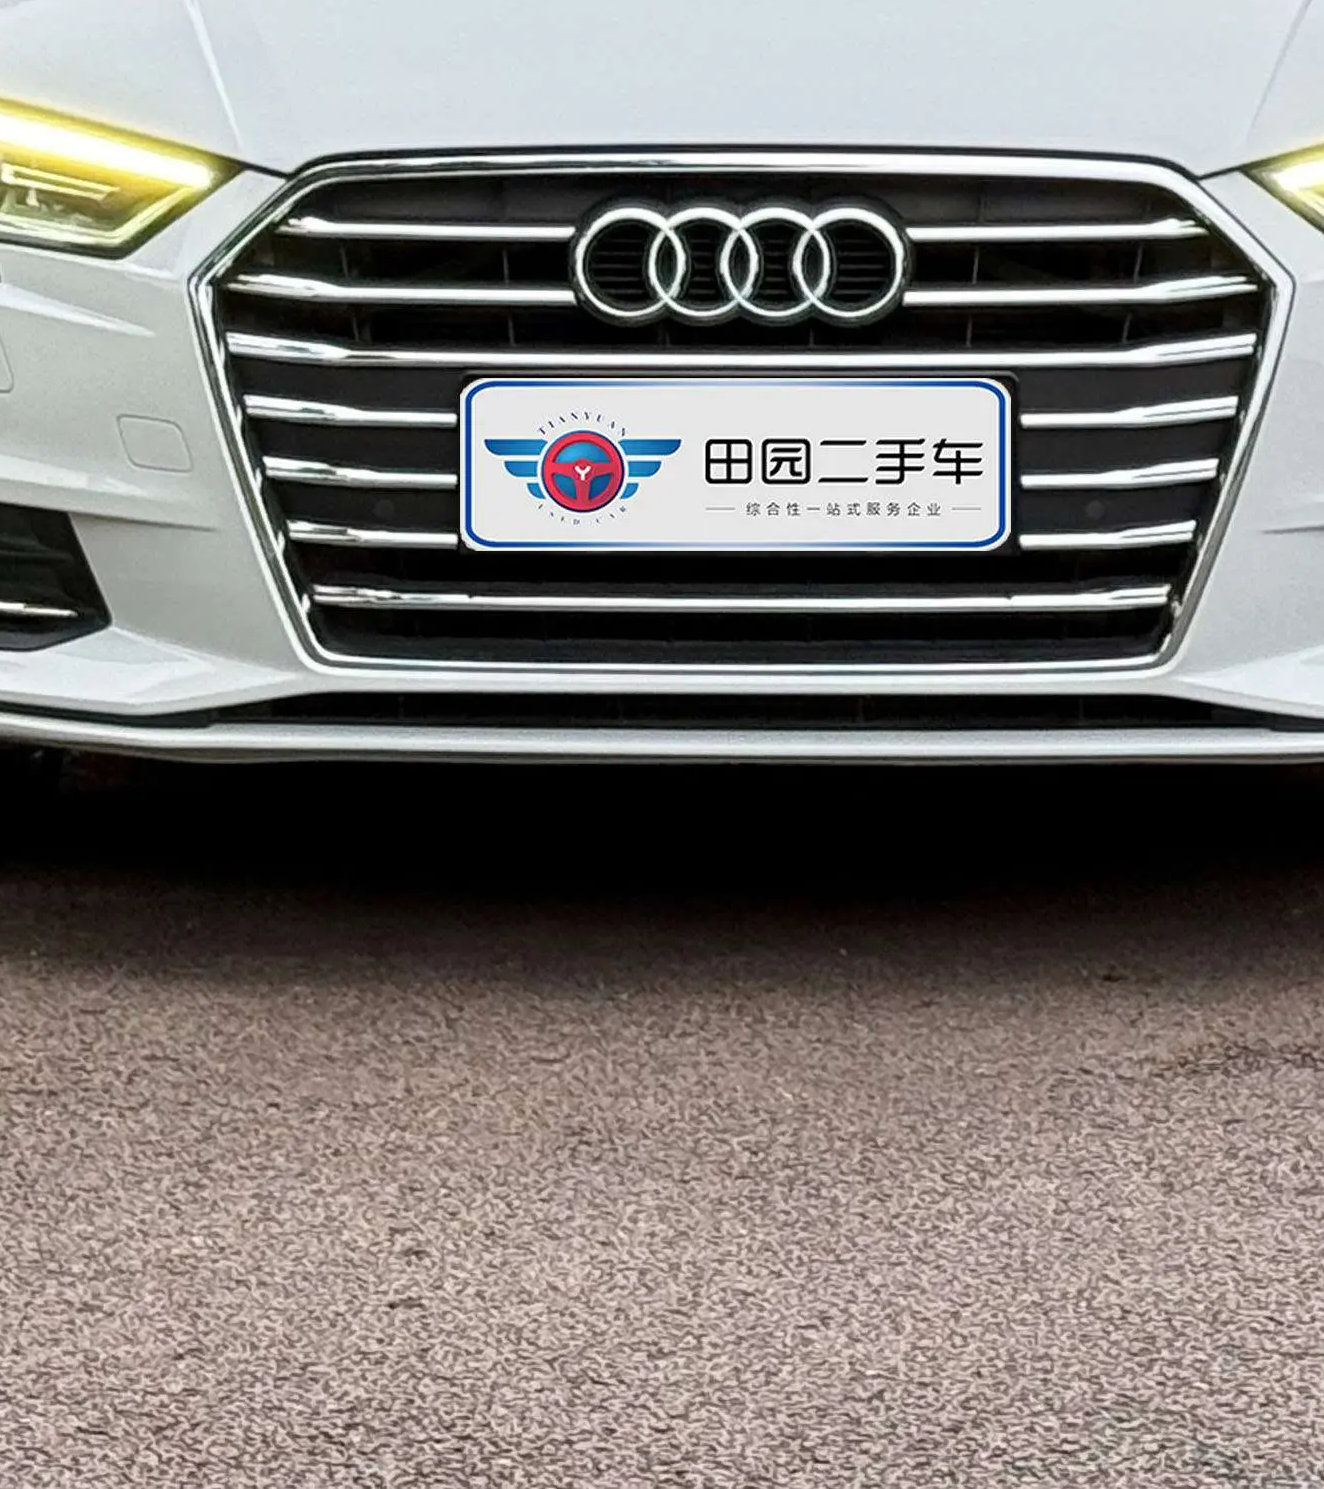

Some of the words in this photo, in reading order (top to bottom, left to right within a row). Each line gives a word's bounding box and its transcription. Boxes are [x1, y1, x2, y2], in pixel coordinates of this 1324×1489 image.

[704, 437, 984, 485] 田园二手车
[745, 501, 942, 517] 综合性一站式服务企业
